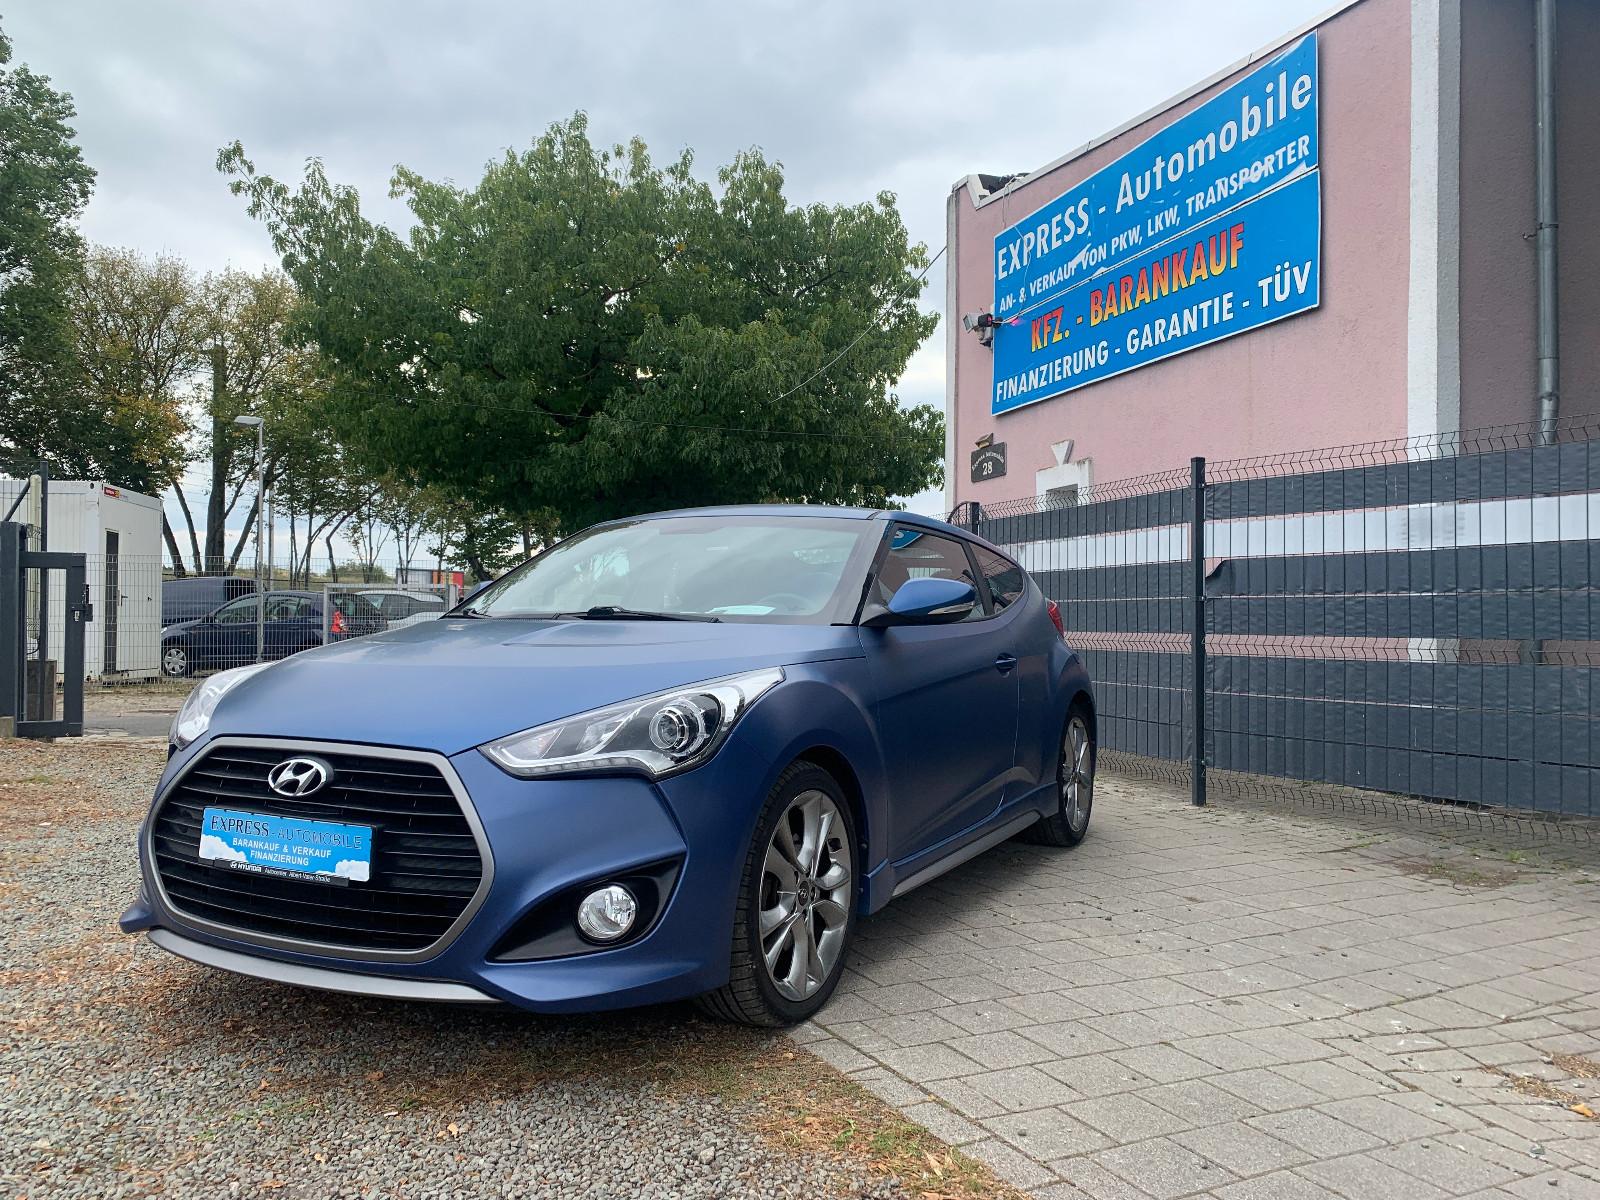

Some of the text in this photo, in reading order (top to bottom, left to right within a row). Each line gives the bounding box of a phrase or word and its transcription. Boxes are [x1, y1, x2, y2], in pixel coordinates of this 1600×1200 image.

[998, 197, 1089, 280] EXPRESS
[1115, 71, 1312, 214] Automobile
[999, 293, 1017, 313] AN-
[1019, 287, 1027, 303] &
[1082, 243, 1107, 270] VON
[1111, 224, 1143, 256] PKW,
[1147, 205, 1181, 237] LKW,
[1186, 134, 1310, 217] TRANSPORTER
[1031, 305, 1070, 352] KFZ.
[1090, 221, 1245, 327] BARANKAUF
[996, 340, 1109, 403] FINANZIERUNG
[1126, 291, 1234, 355] GARANTIE
[1258, 260, 1312, 308] TÜV
[982, 461, 993, 476] 28
[211, 815, 269, 837] EXPRESS
[277, 827, 363, 850] AUTOMOBILE
[232, 837, 332, 859] BARANKAUF & VERKAUF
[250, 849, 309, 866] FINANZIERUNG
